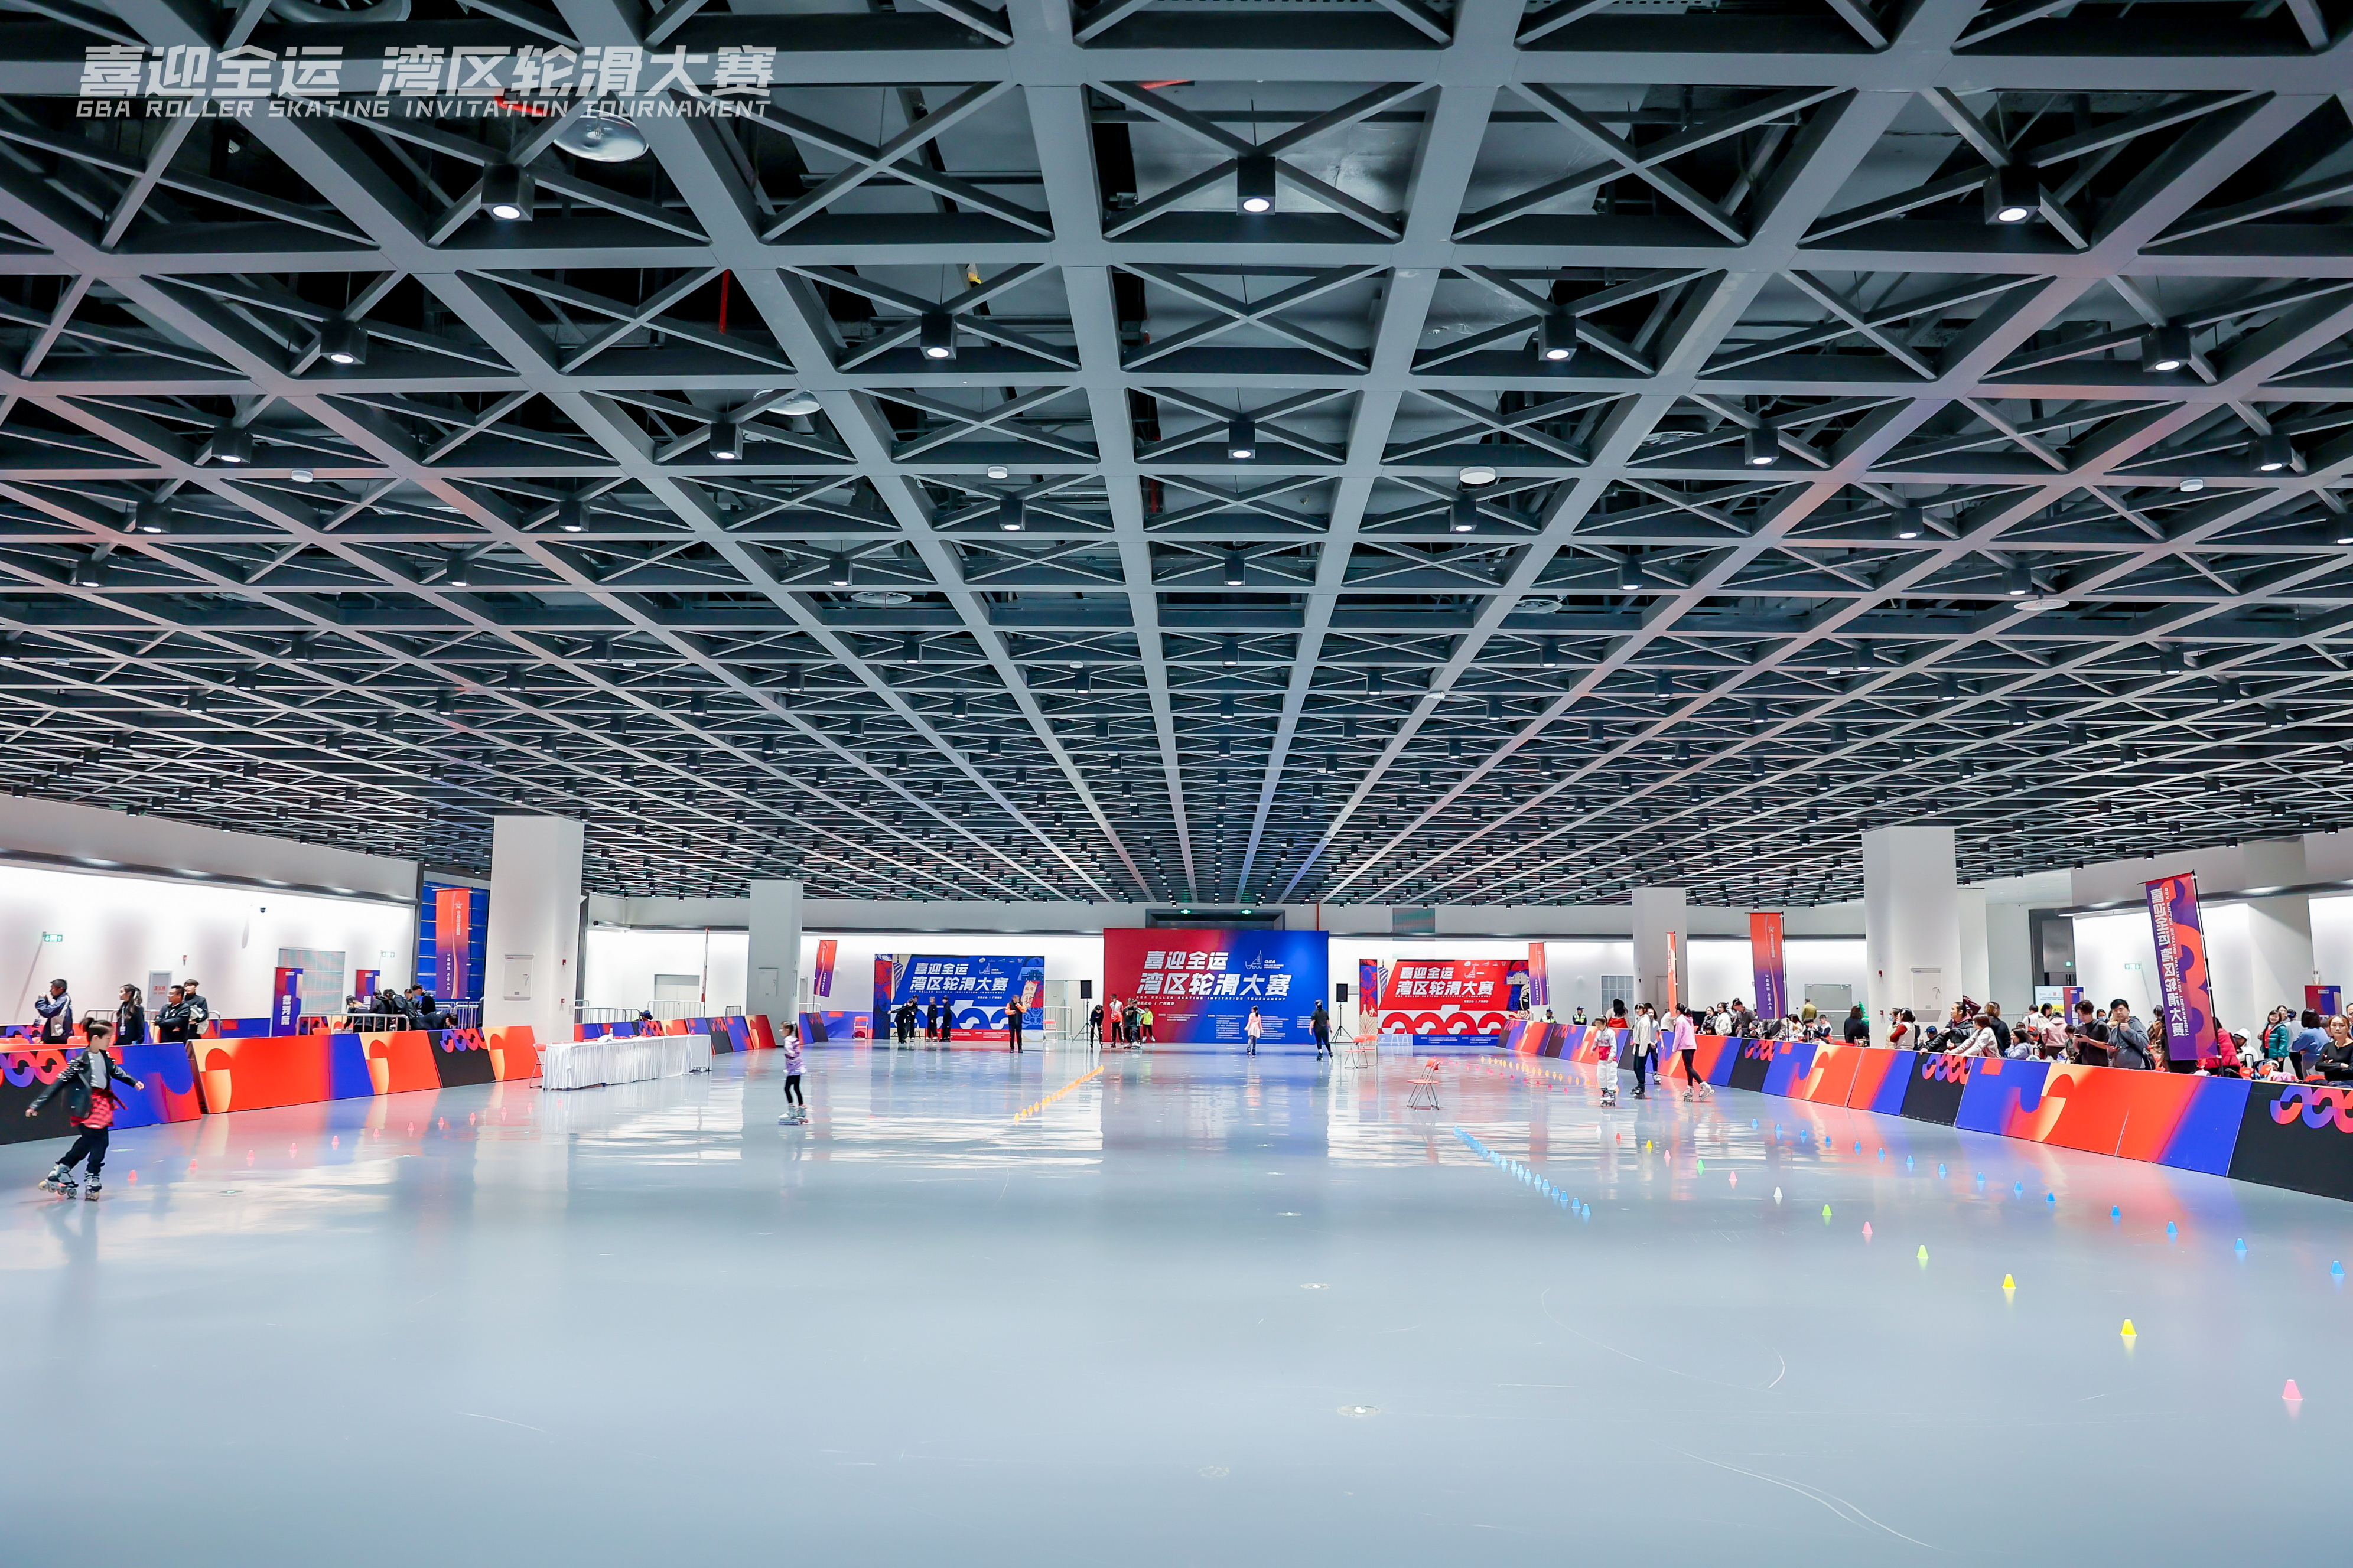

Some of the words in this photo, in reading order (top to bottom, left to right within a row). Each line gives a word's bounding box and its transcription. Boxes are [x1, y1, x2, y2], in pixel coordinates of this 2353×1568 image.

[1144, 951, 1229, 970] 喜迎全运
[914, 963, 969, 975] 喜迎全运
[1400, 967, 1454, 979] 喜迎全运
[909, 976, 1009, 992] 湾区轮滑大赛
[1136, 973, 1292, 996] 湾区轮滑大赛
[1395, 980, 1495, 995] 湾区轮滑大赛
